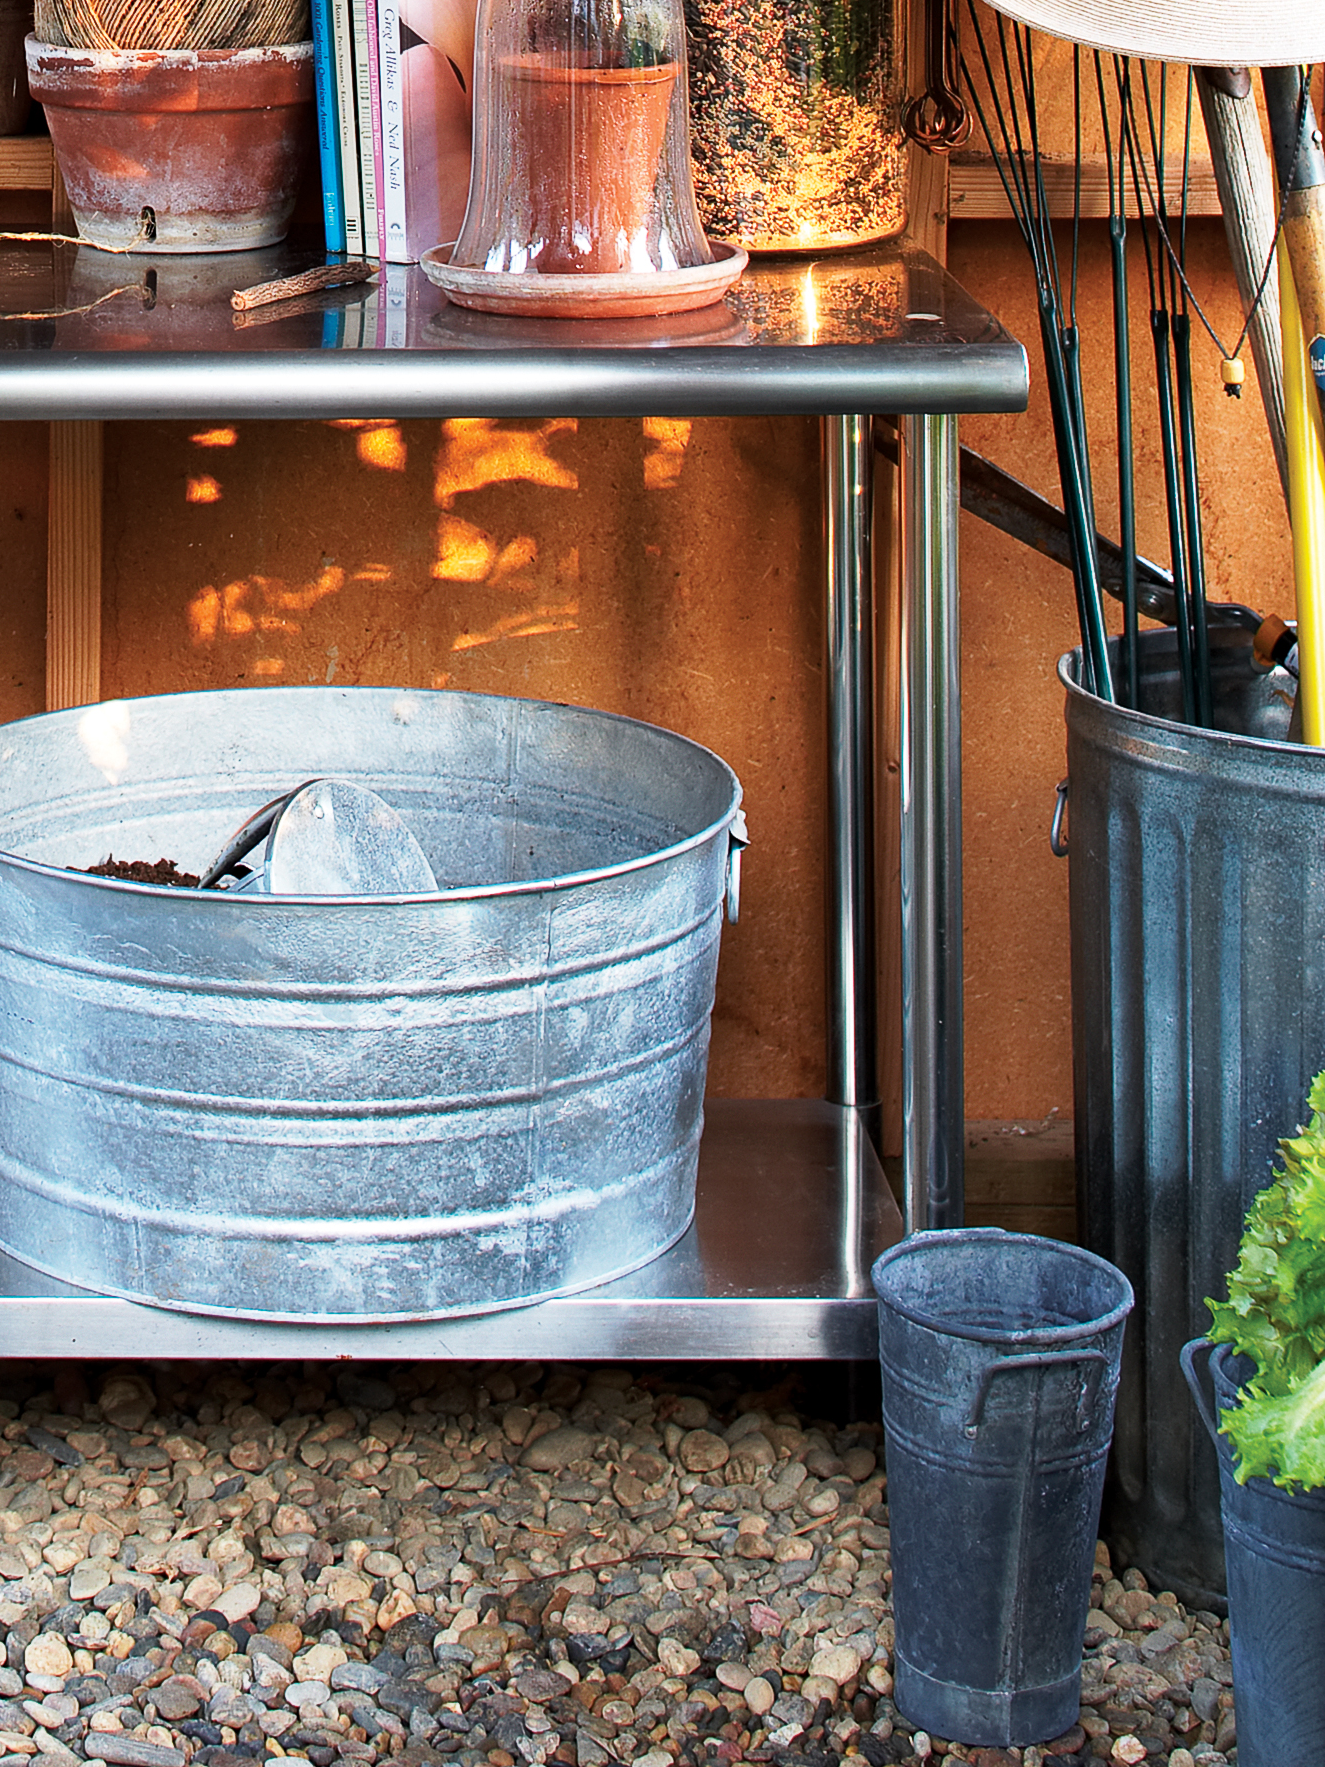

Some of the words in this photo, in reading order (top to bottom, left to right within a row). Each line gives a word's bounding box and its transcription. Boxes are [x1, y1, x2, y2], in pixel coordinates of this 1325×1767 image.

[383, 8, 395, 40] Greg
[315, 22, 325, 66] Gardening
[385, 42, 397, 90] Allikas
[317, 66, 326, 109] Questions
[387, 100, 399, 112] &
[389, 122, 400, 150] Ned
[389, 155, 401, 190] Nash
